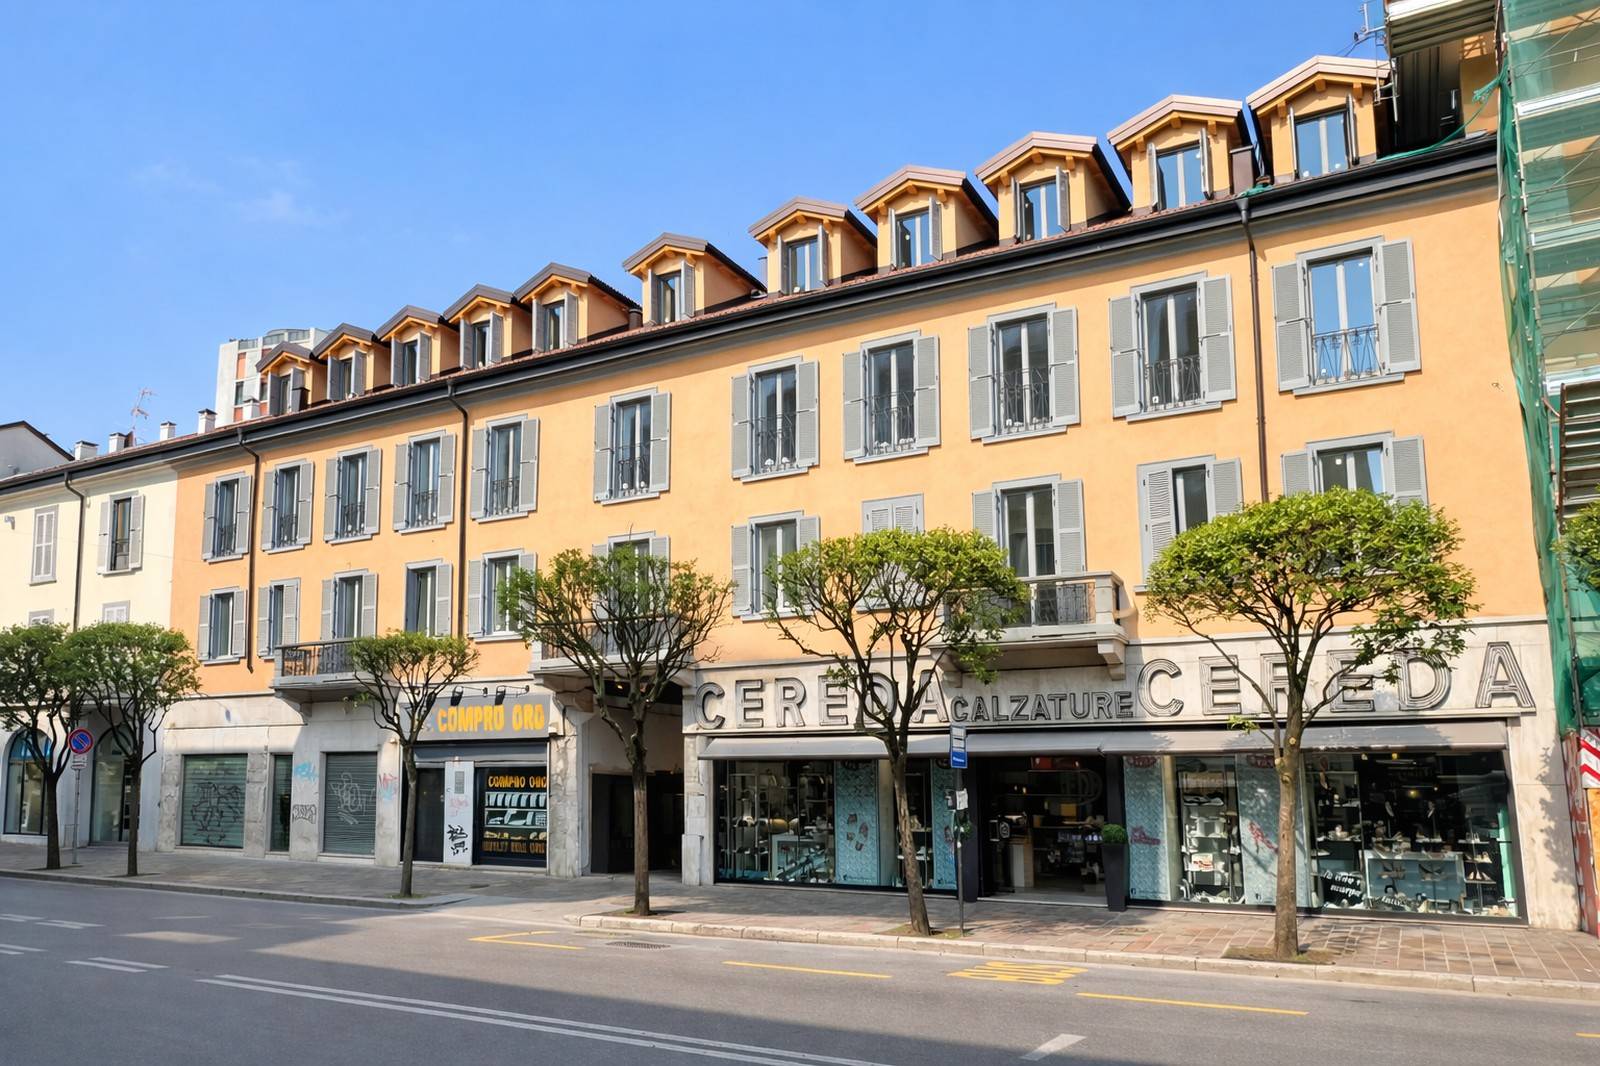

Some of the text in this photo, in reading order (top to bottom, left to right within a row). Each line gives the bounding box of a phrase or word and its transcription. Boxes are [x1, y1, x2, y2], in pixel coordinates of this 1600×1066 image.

[437, 704, 545, 732] COMPRO ORO
[950, 691, 1134, 722] CALZATURE
